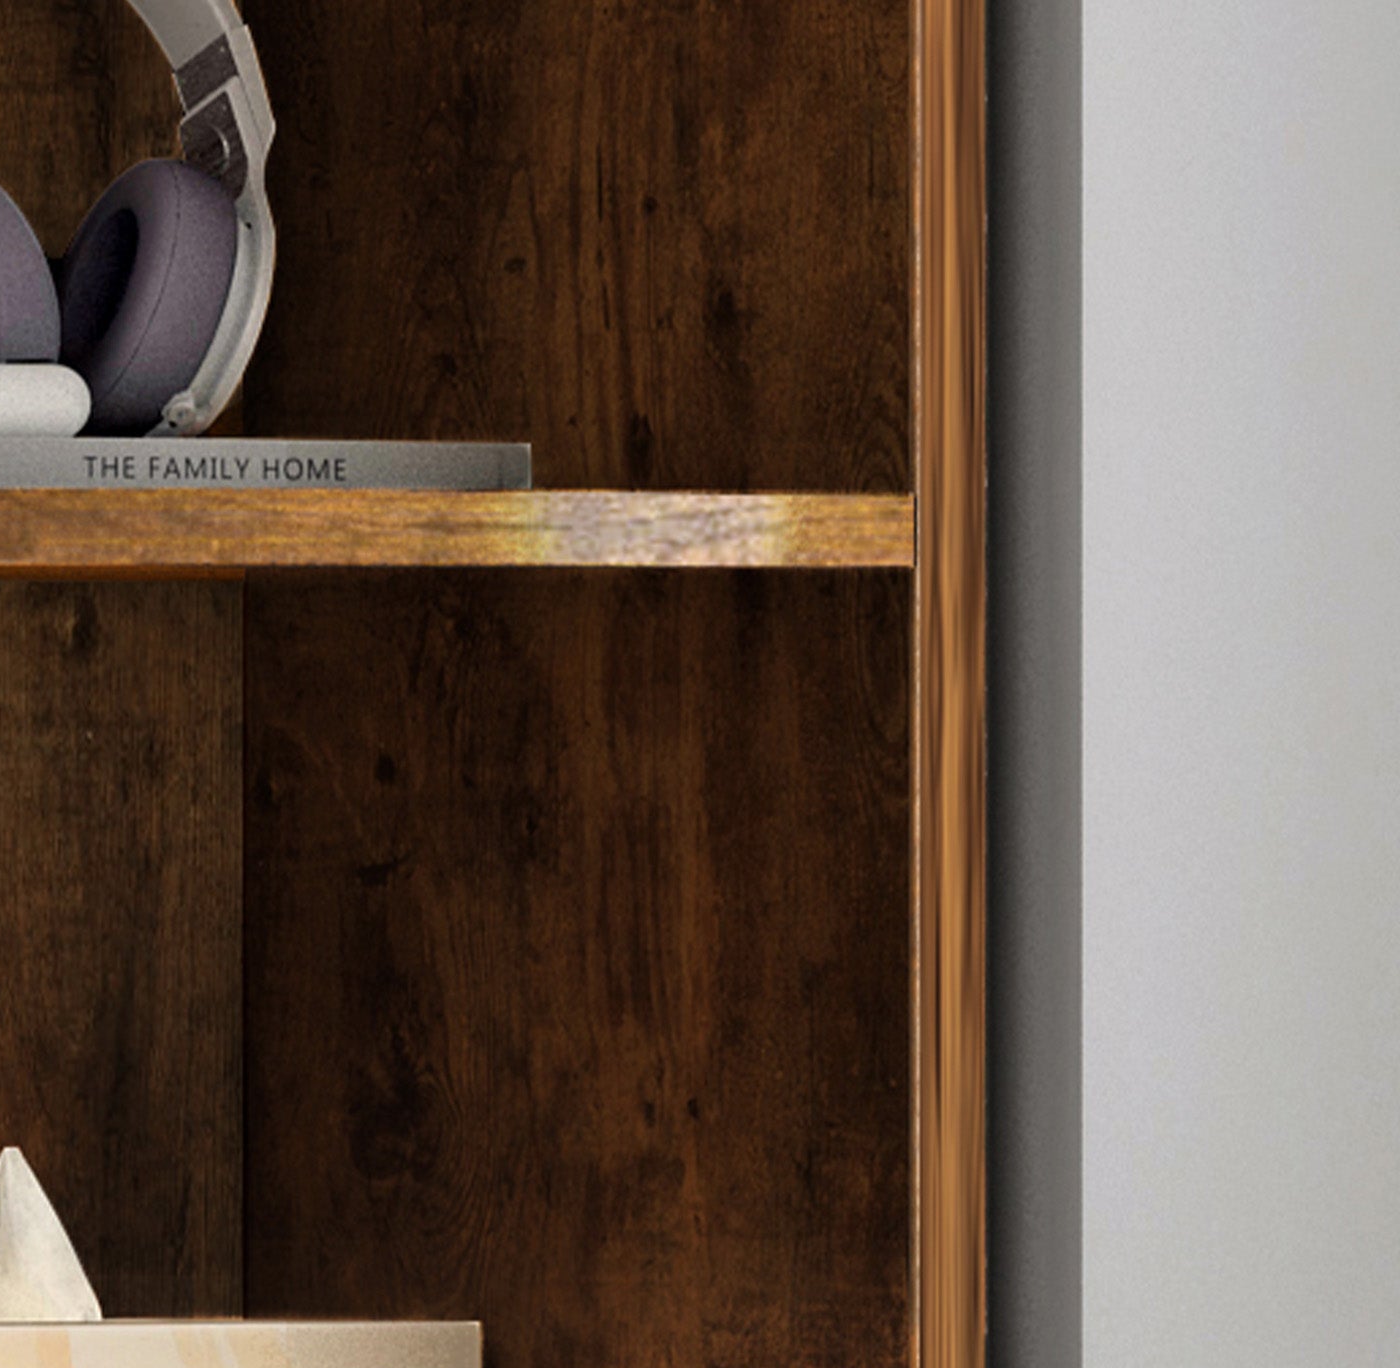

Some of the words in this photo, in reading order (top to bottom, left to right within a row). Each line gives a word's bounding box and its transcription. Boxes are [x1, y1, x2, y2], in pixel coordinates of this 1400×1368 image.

[84, 456, 135, 479] THE
[149, 456, 250, 480] FAMILY
[262, 458, 347, 481] HOME
